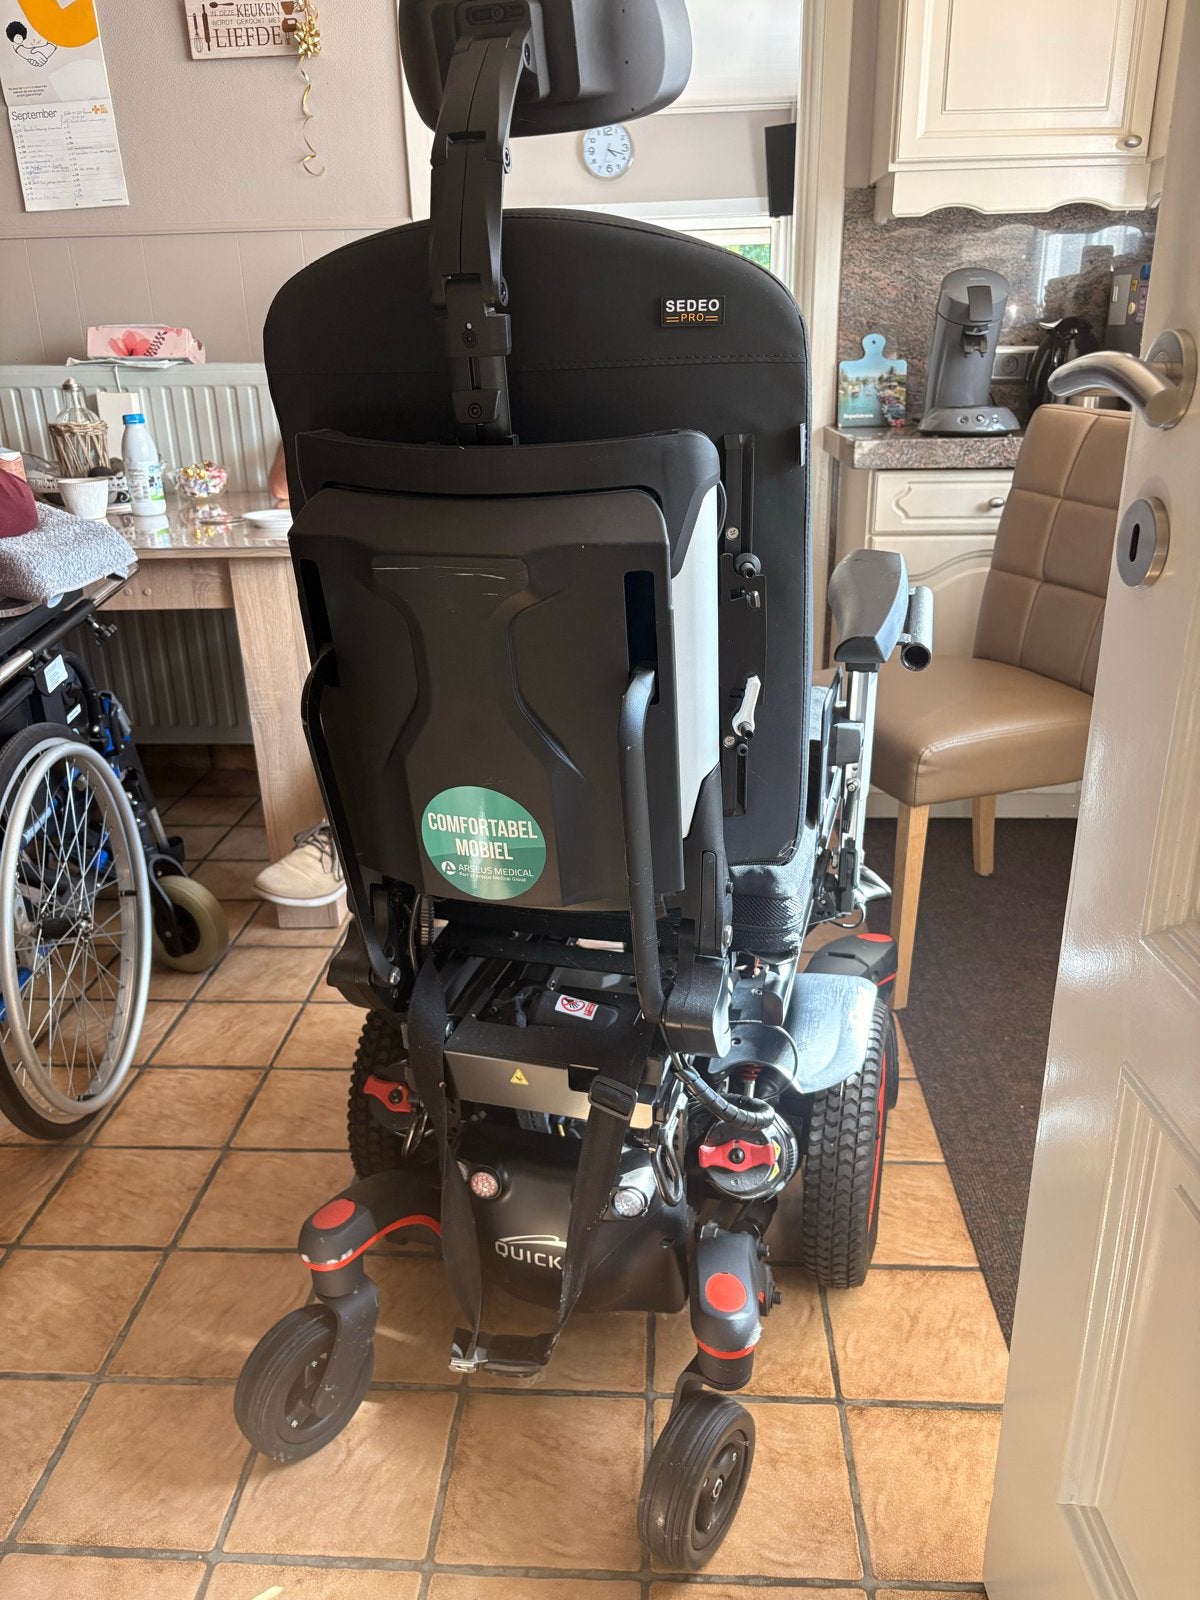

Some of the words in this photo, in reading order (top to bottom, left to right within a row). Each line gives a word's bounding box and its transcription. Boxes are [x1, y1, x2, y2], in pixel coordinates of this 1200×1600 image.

[235, 3, 280, 17] KEUKEN
[213, 26, 283, 48] LIEFDE
[11, 110, 57, 122] September
[603, 126, 612, 136] 12
[588, 146, 595, 155] 9
[622, 143, 629, 152] 3
[606, 165, 613, 173] 6
[665, 299, 720, 313] SEDEO
[681, 313, 704, 322] PRO
[427, 812, 538, 839] COMFORTABEL
[455, 838, 513, 860] MOBIEL
[458, 864, 493, 875] ARSEUS
[494, 867, 535, 877] MEDICAL
[495, 1241, 564, 1272] QUICK
